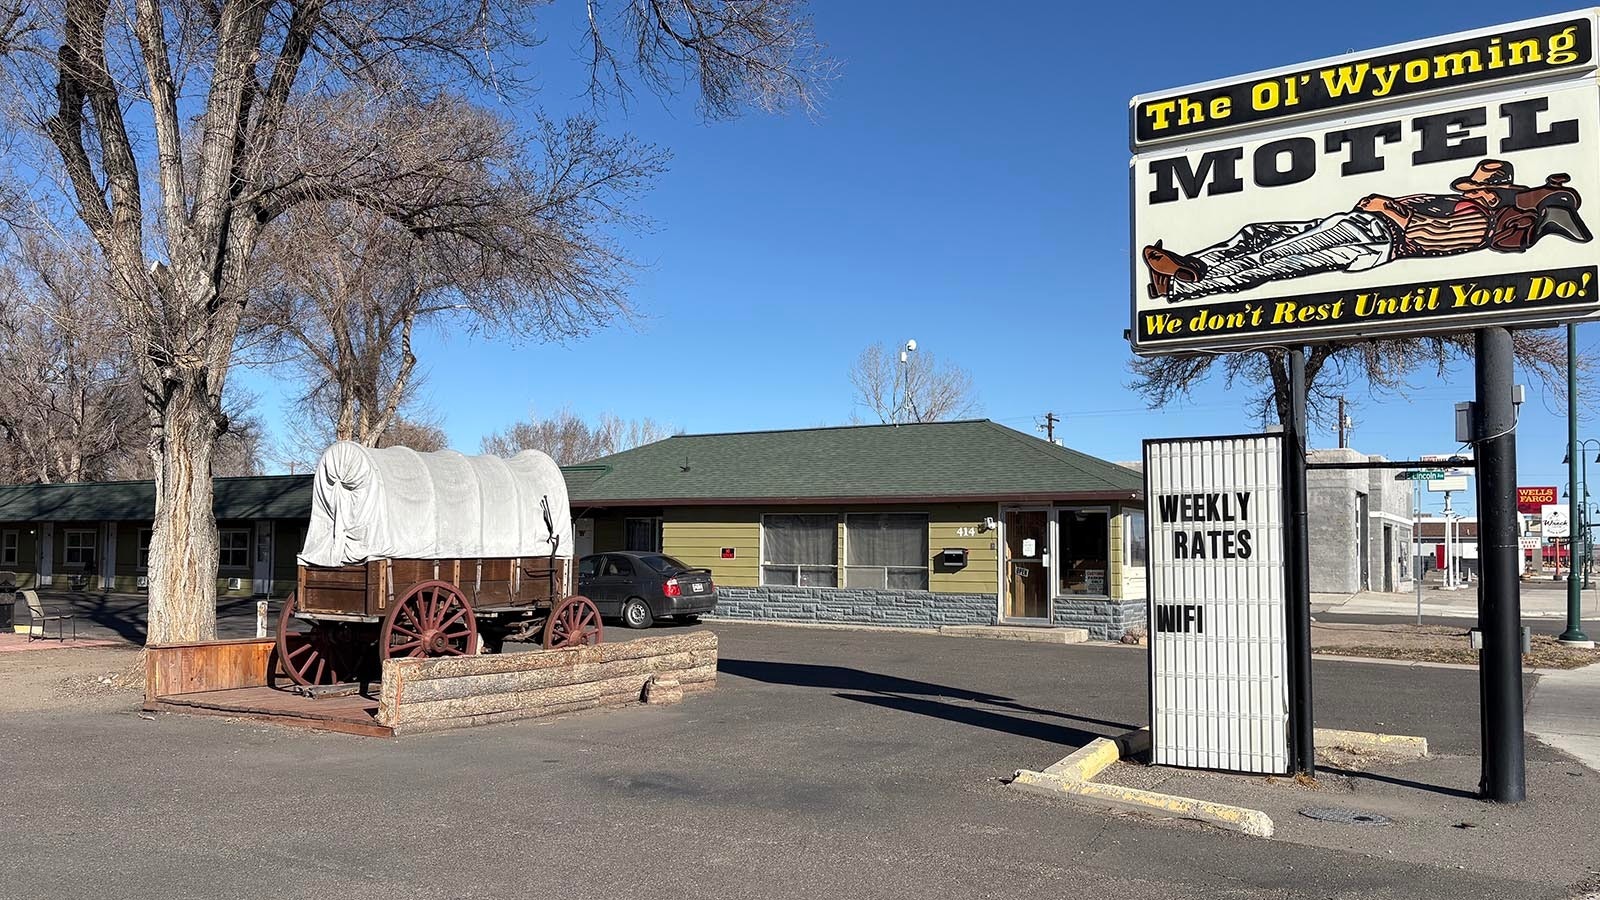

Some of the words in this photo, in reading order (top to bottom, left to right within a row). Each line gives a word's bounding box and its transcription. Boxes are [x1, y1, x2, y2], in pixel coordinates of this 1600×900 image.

[1146, 95, 1233, 131] The
[1320, 25, 1580, 96] Wyoming
[1149, 96, 1580, 205] MOTEL
[1144, 312, 1182, 336] We
[1270, 296, 1345, 325] Rest
[1355, 286, 1440, 316] Until
[1450, 279, 1518, 306] You
[1527, 272, 1591, 302] Do!
[1412, 472, 1437, 480] Lincoln
[1158, 491, 1251, 523] WEEKLY
[1519, 488, 1553, 496] WELLS
[956, 527, 976, 537] 414
[1174, 529, 1252, 560] RATES
[1016, 567, 1028, 576] OPEN
[1156, 605, 1203, 634] WIFI
